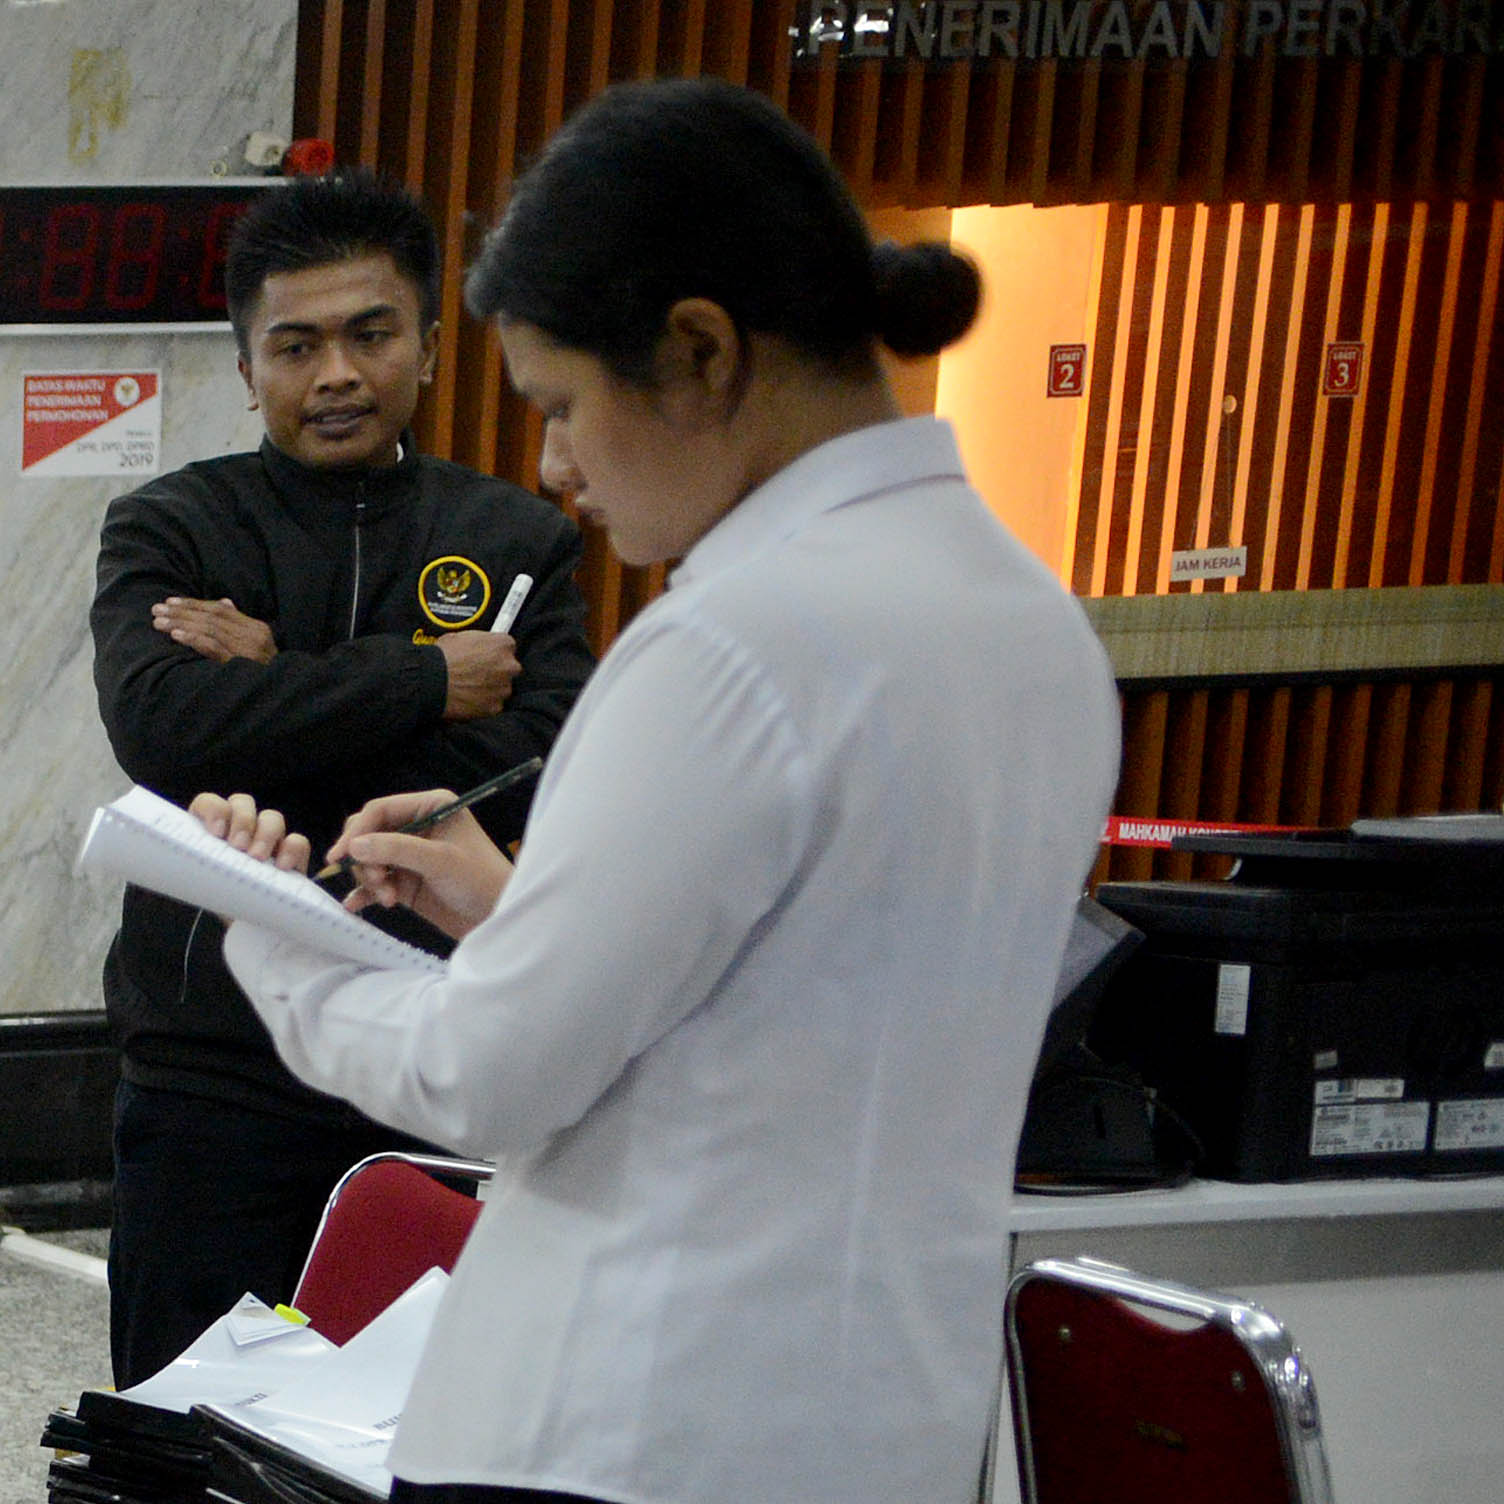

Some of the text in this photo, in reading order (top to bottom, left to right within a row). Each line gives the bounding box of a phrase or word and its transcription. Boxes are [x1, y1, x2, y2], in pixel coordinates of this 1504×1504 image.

[804, 0, 1502, 58] PENERIMAAN PERKAR
[1059, 363, 1074, 389] 2
[1334, 362, 1349, 387] 3
[1175, 556, 1242, 572] JAM KERJA
